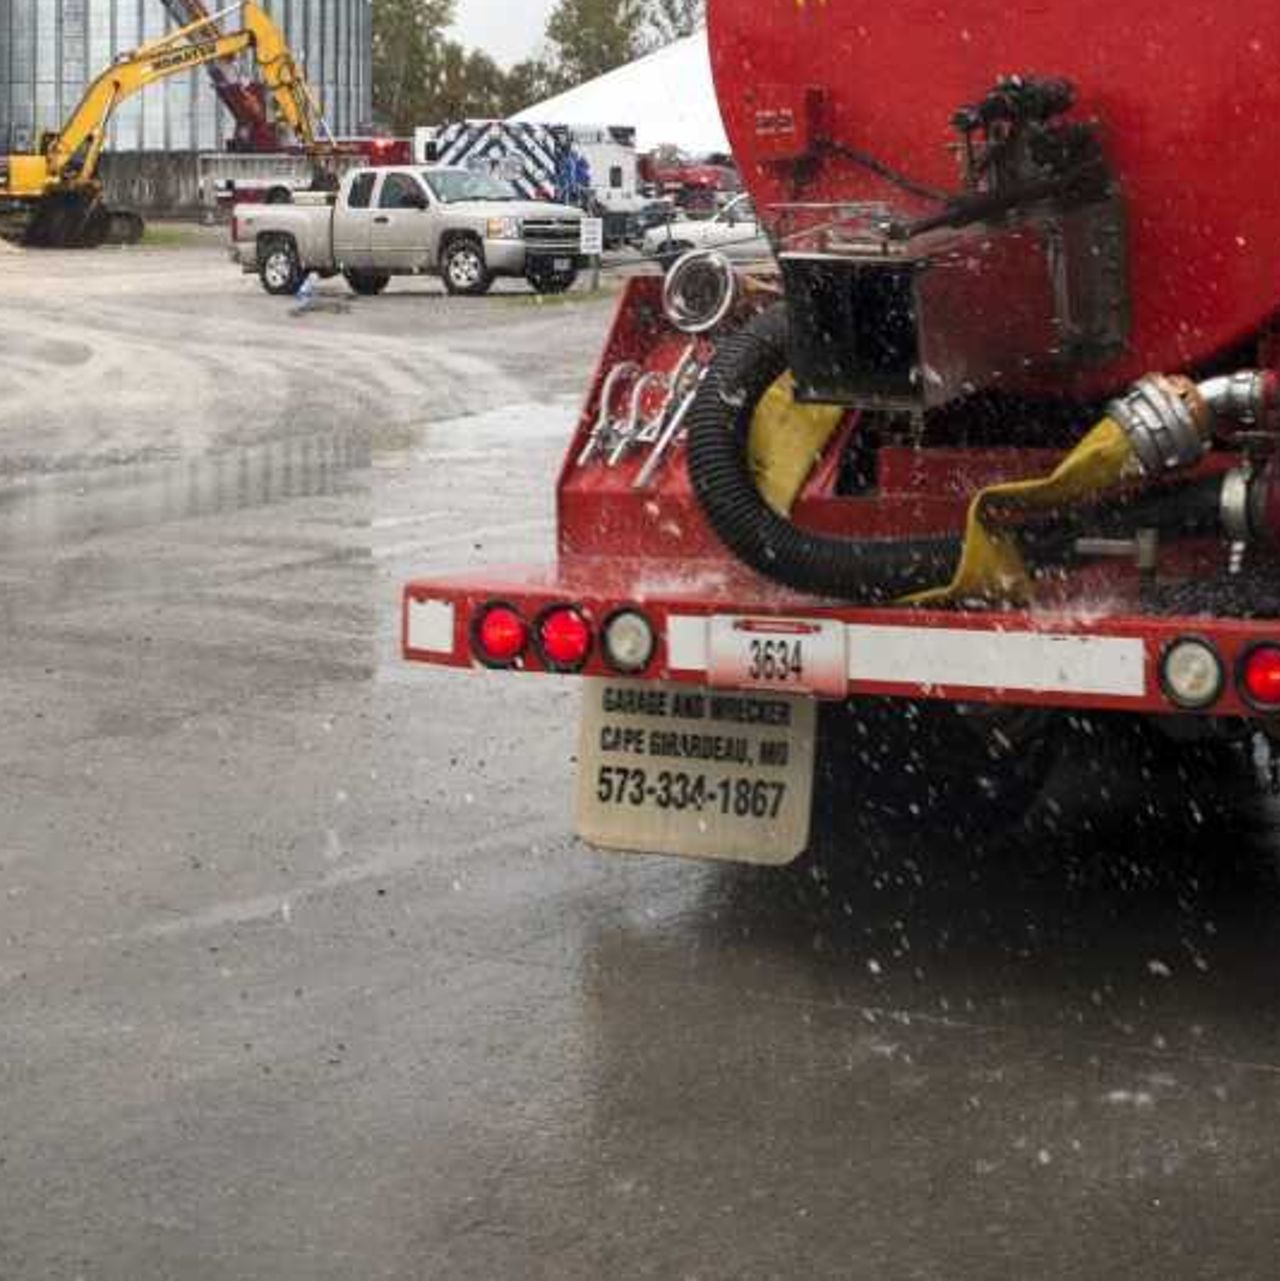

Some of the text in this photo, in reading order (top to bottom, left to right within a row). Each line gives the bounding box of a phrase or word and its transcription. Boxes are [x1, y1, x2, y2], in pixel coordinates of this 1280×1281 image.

[749, 639, 803, 681] 3634
[602, 687, 667, 716] GARAGE
[672, 692, 705, 719] AND
[600, 725, 790, 767] CAPE GIRARDEAU, MO
[596, 765, 787, 819] 573-334-1867
